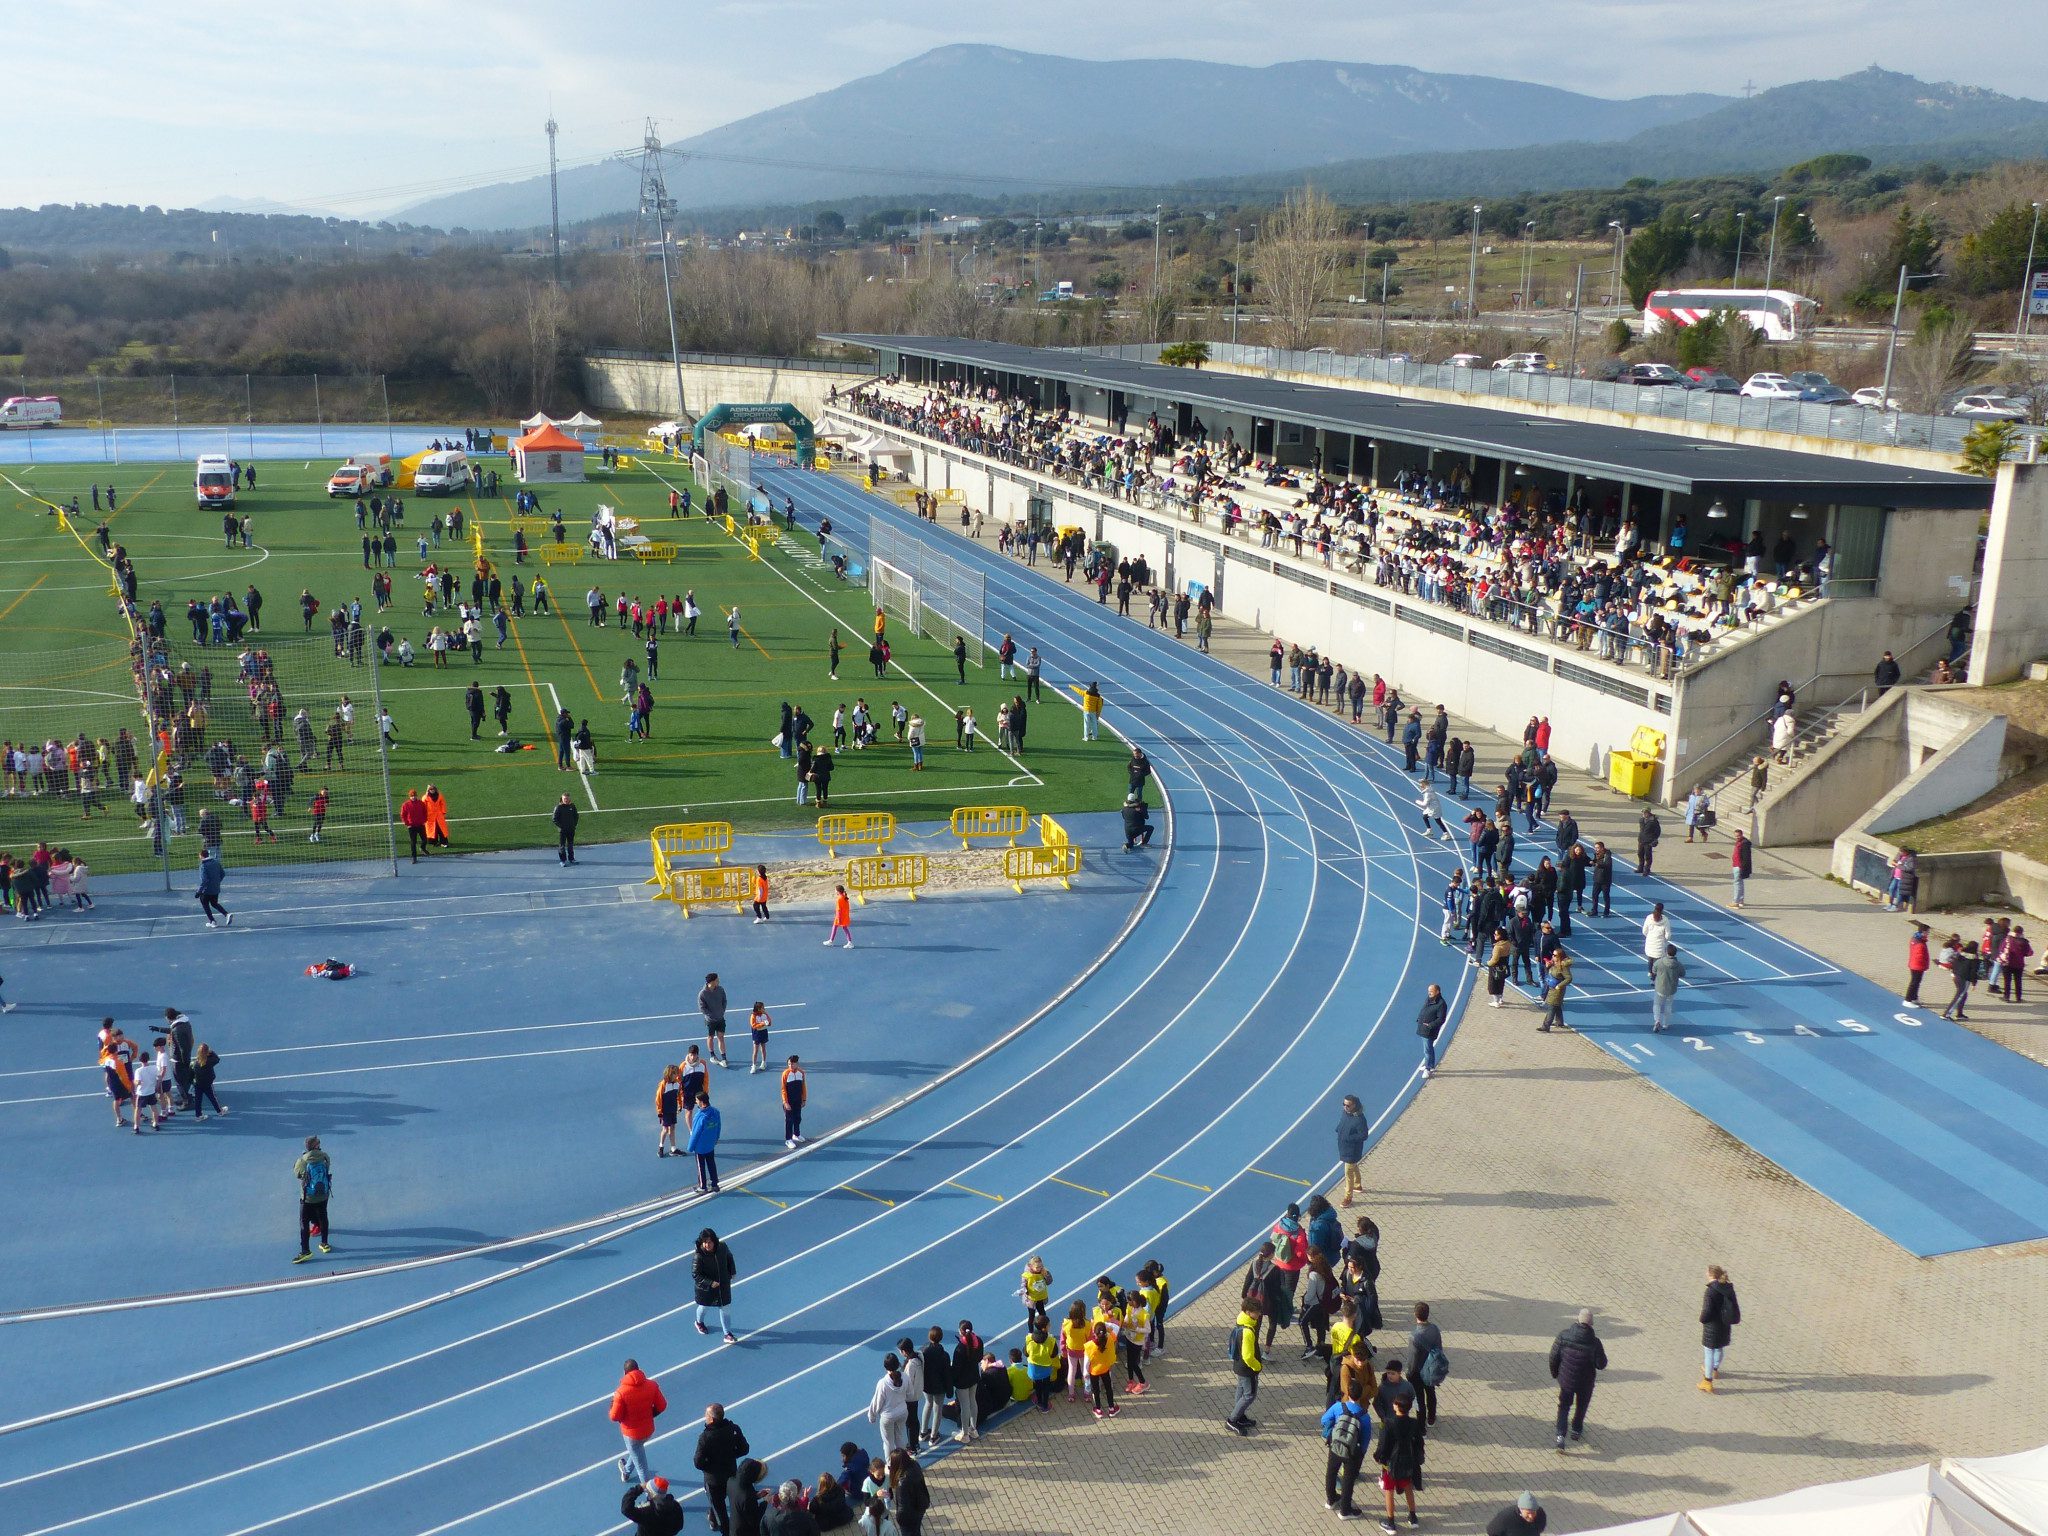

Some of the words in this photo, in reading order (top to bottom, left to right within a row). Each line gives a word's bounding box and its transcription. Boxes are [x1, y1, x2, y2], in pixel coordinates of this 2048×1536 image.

[788, 417, 806, 426] dxt
[1630, 1043, 1656, 1056] 1
[1683, 1037, 1715, 1051] 2
[1734, 1031, 1765, 1044] 3
[1794, 1024, 1822, 1038] 4
[1836, 1018, 1871, 1033] 5
[1893, 1012, 1923, 1027] 6
